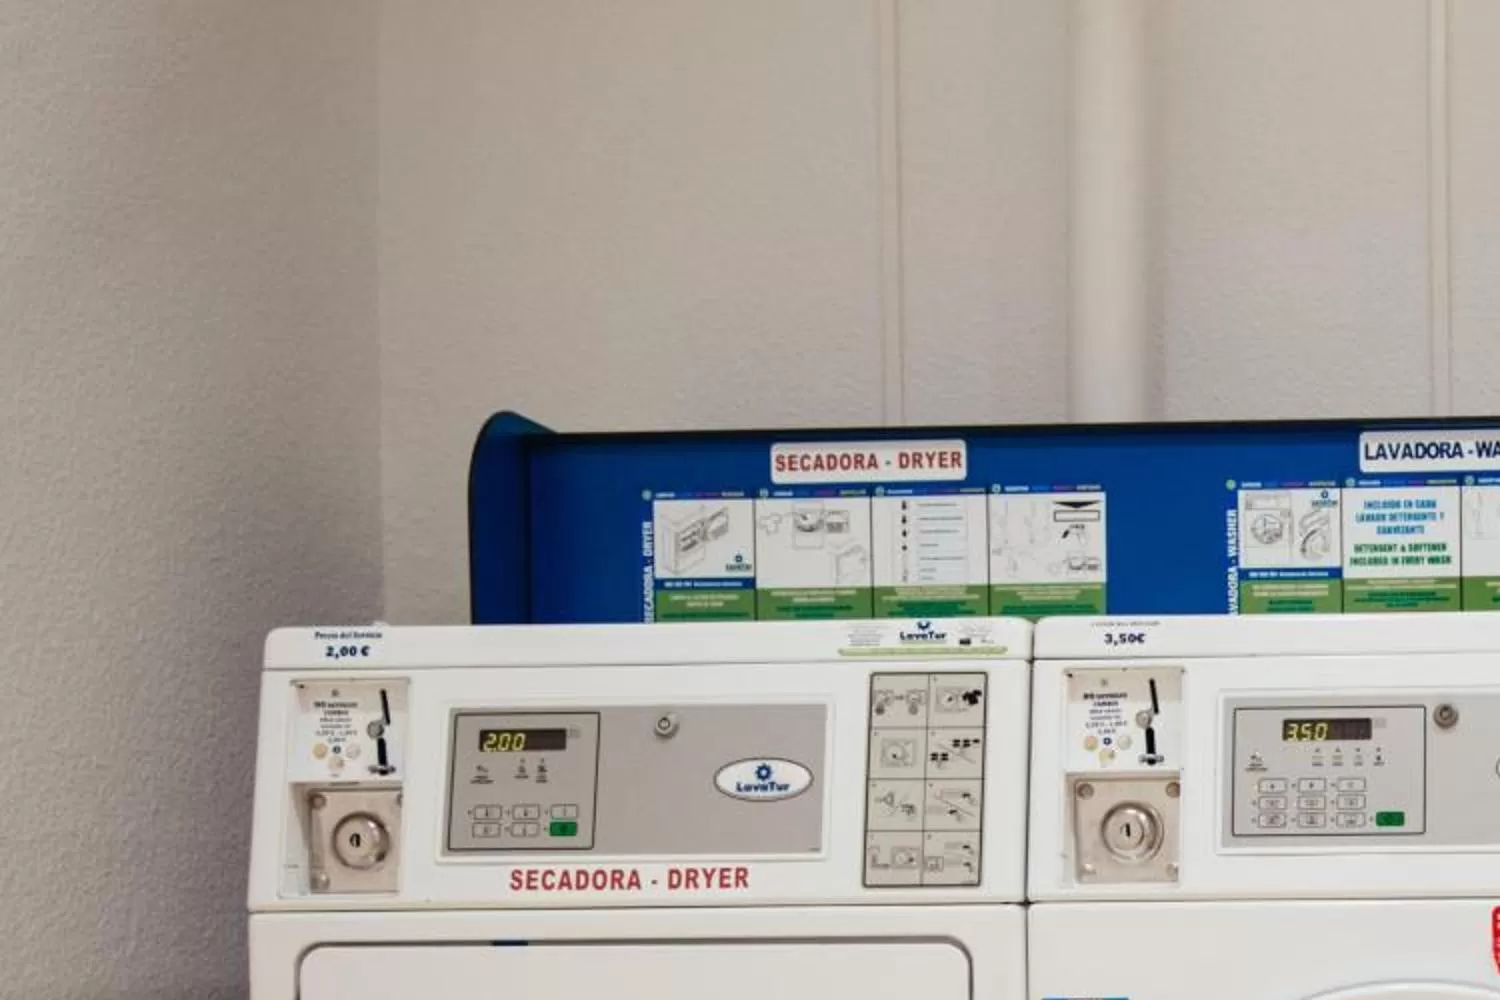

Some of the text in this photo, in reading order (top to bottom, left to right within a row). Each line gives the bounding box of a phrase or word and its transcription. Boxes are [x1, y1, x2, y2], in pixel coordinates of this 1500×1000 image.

[774, 451, 879, 473] SECADORA
[898, 450, 963, 471] DRYER
[1364, 440, 1463, 461] LAVADORA
[1104, 632, 1146, 647] 3,50€
[510, 869, 642, 891] SECADORA
[668, 866, 749, 889] DRYER
